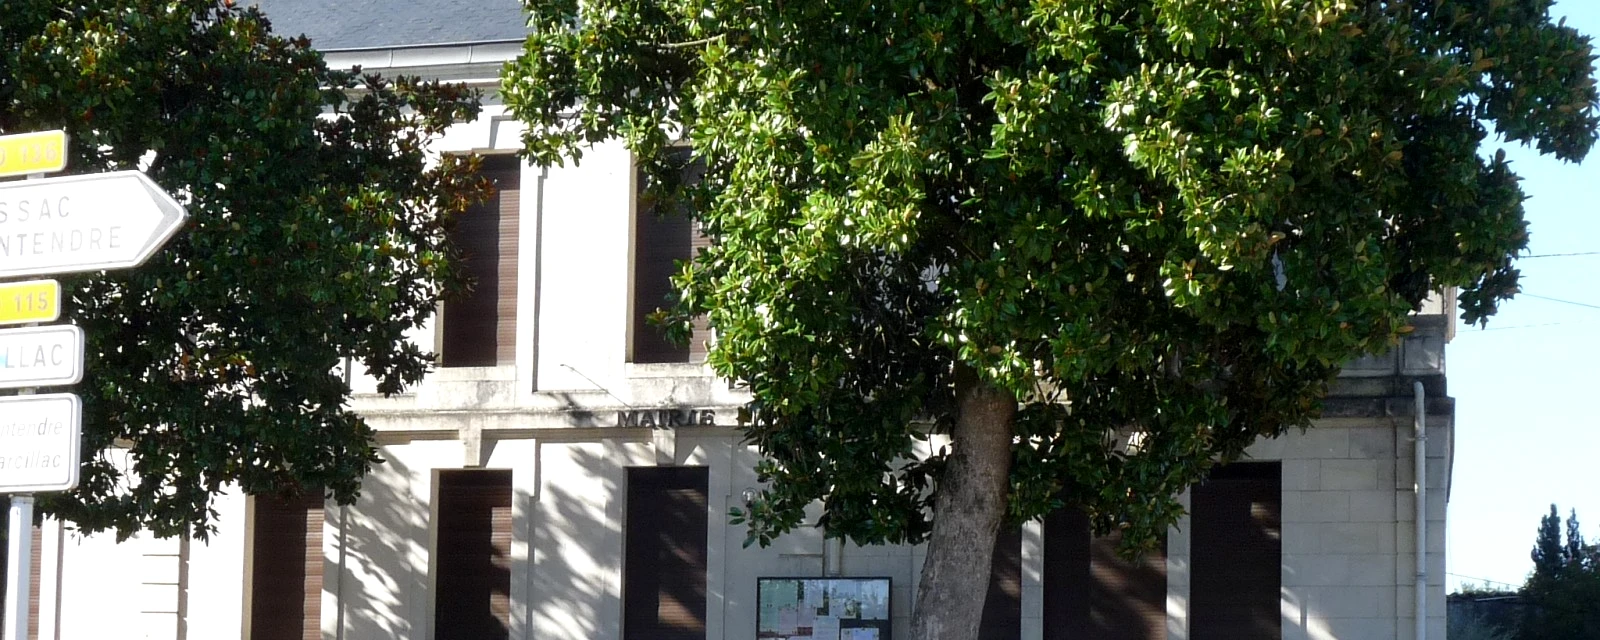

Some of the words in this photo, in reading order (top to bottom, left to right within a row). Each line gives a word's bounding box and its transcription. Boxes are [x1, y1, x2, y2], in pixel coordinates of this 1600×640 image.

[0, 196, 70, 224] SSAC
[0, 226, 121, 257] NTENDRE
[14, 291, 48, 313] 115
[4, 344, 63, 368] LLAC
[617, 408, 716, 430] MAIRIE
